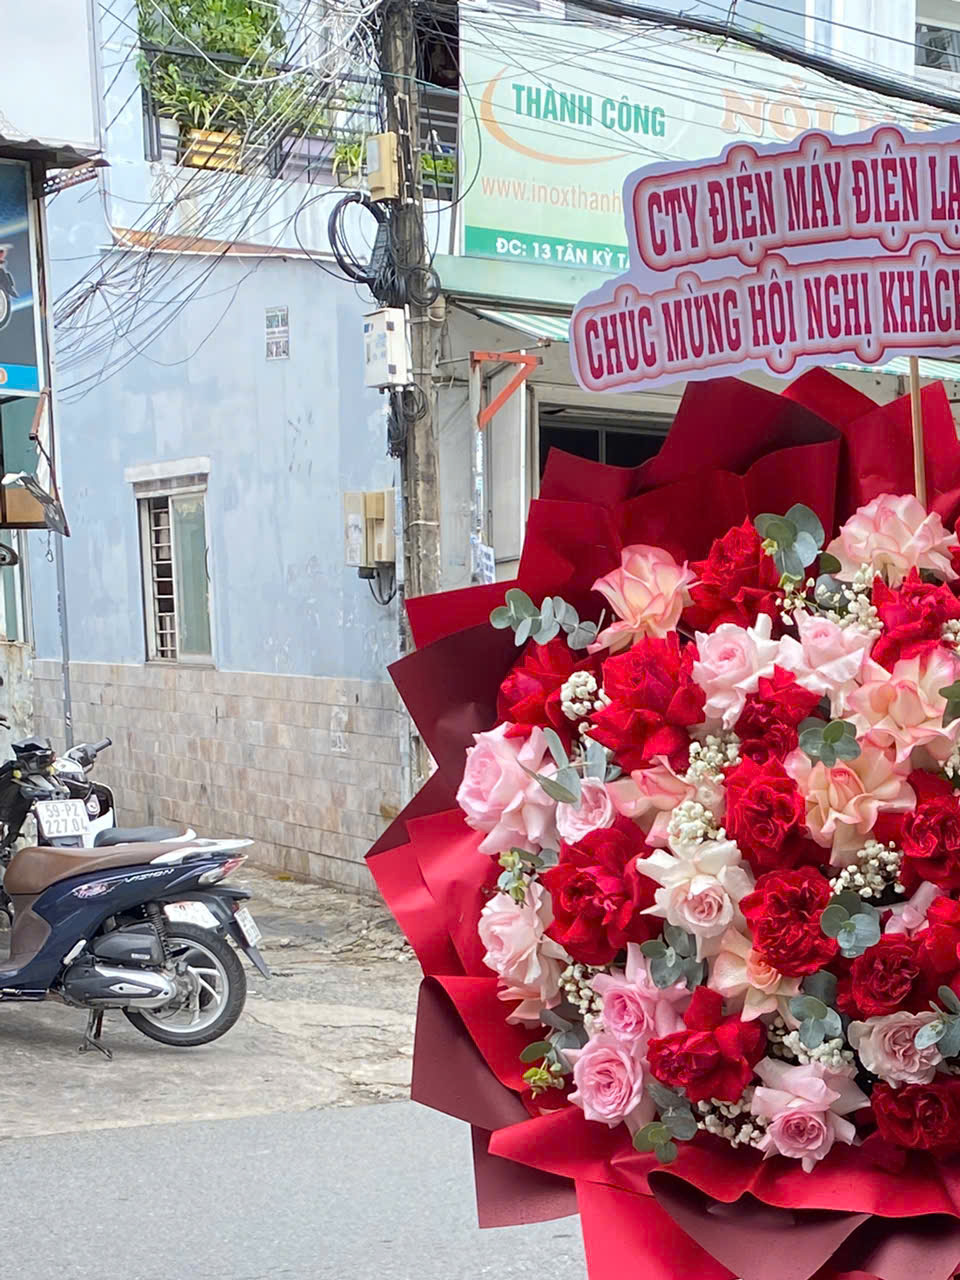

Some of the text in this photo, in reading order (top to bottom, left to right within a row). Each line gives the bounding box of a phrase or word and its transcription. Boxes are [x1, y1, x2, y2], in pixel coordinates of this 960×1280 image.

[511, 82, 666, 137] THÀNH CÔNG
[481, 176, 622, 214] www.inoxthanh
[647, 184, 699, 256] CTY
[707, 160, 776, 252] ĐIỆN
[783, 148, 841, 232] MÁY
[851, 143, 920, 237] ĐIỆN
[496, 237, 527, 256] ĐC:
[532, 242, 551, 259] 13
[556, 243, 587, 264] TÂN
[592, 248, 613, 268] KỲ
[585, 296, 657, 380] CHÚC
[661, 283, 742, 362] MỪNG
[747, 268, 797, 359] HỘI
[804, 272, 872, 349] NGHỊ
